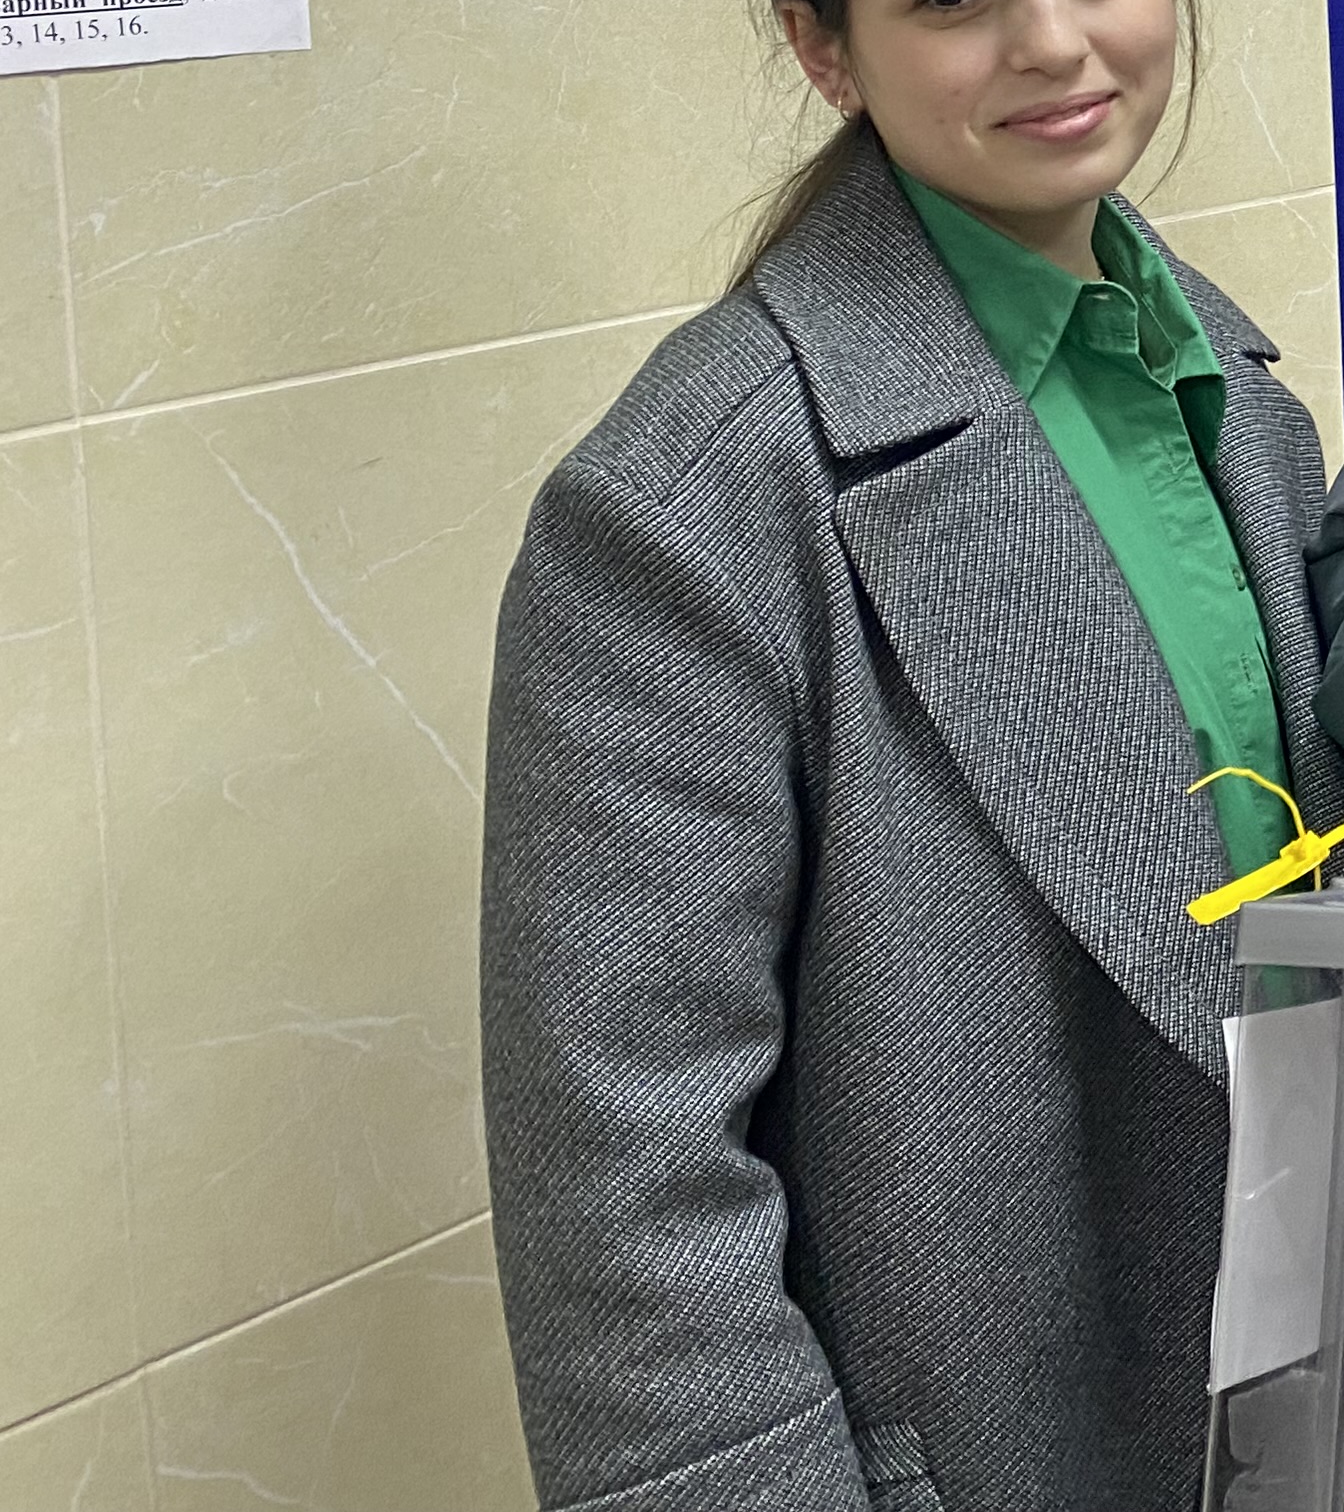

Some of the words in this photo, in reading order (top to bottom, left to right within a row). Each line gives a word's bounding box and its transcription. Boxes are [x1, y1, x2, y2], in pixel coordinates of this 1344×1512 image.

[1, 26, 22, 47] 3,
[33, 22, 65, 45] 14,
[76, 19, 108, 41] 15,
[118, 15, 148, 36] 16.
